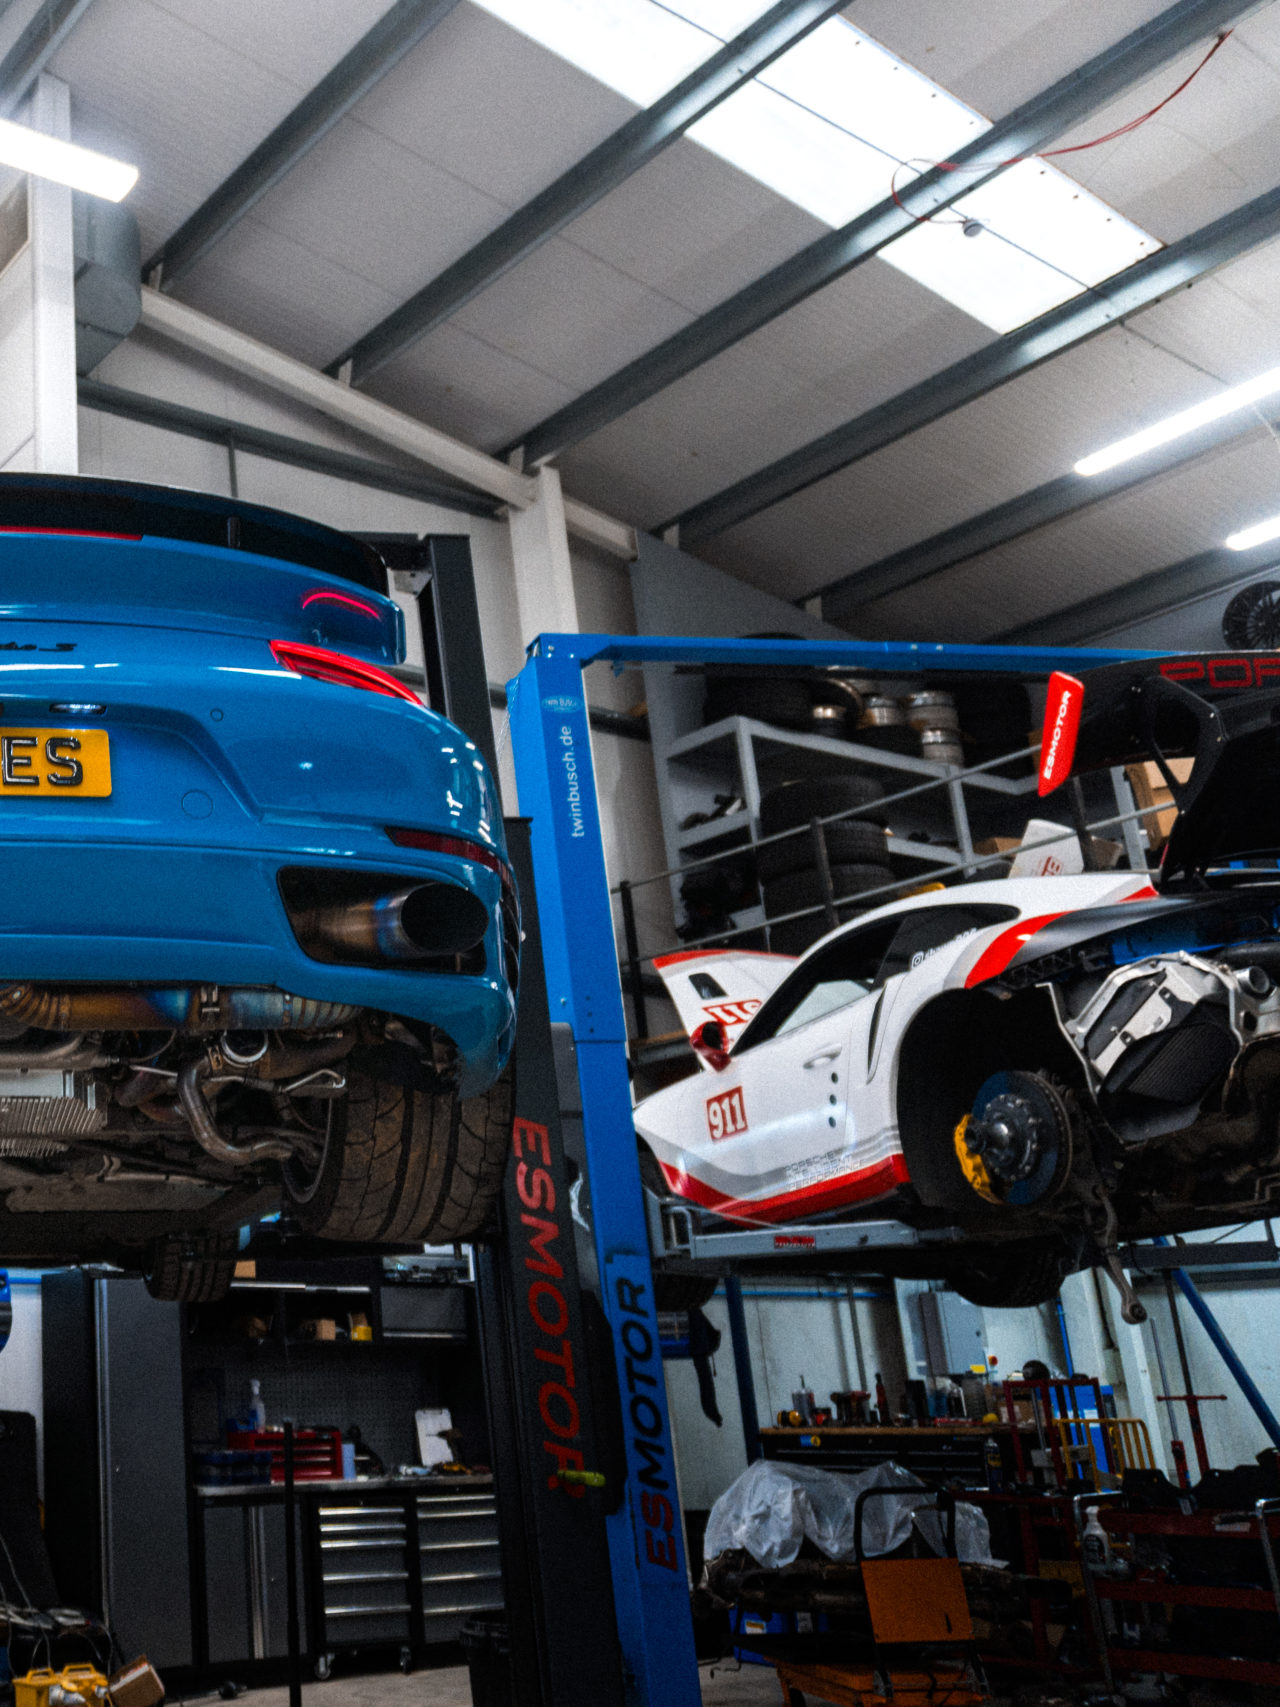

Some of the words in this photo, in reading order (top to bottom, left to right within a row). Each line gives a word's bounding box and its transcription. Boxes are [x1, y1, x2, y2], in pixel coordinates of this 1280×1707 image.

[559, 726, 585, 838] twinbusch.de
[1043, 690, 1072, 780] ESMOTOR
[708, 1093, 746, 1140] 911
[513, 1116, 586, 1499] ESMOTOR
[618, 1277, 678, 1571] ESMOTOR
